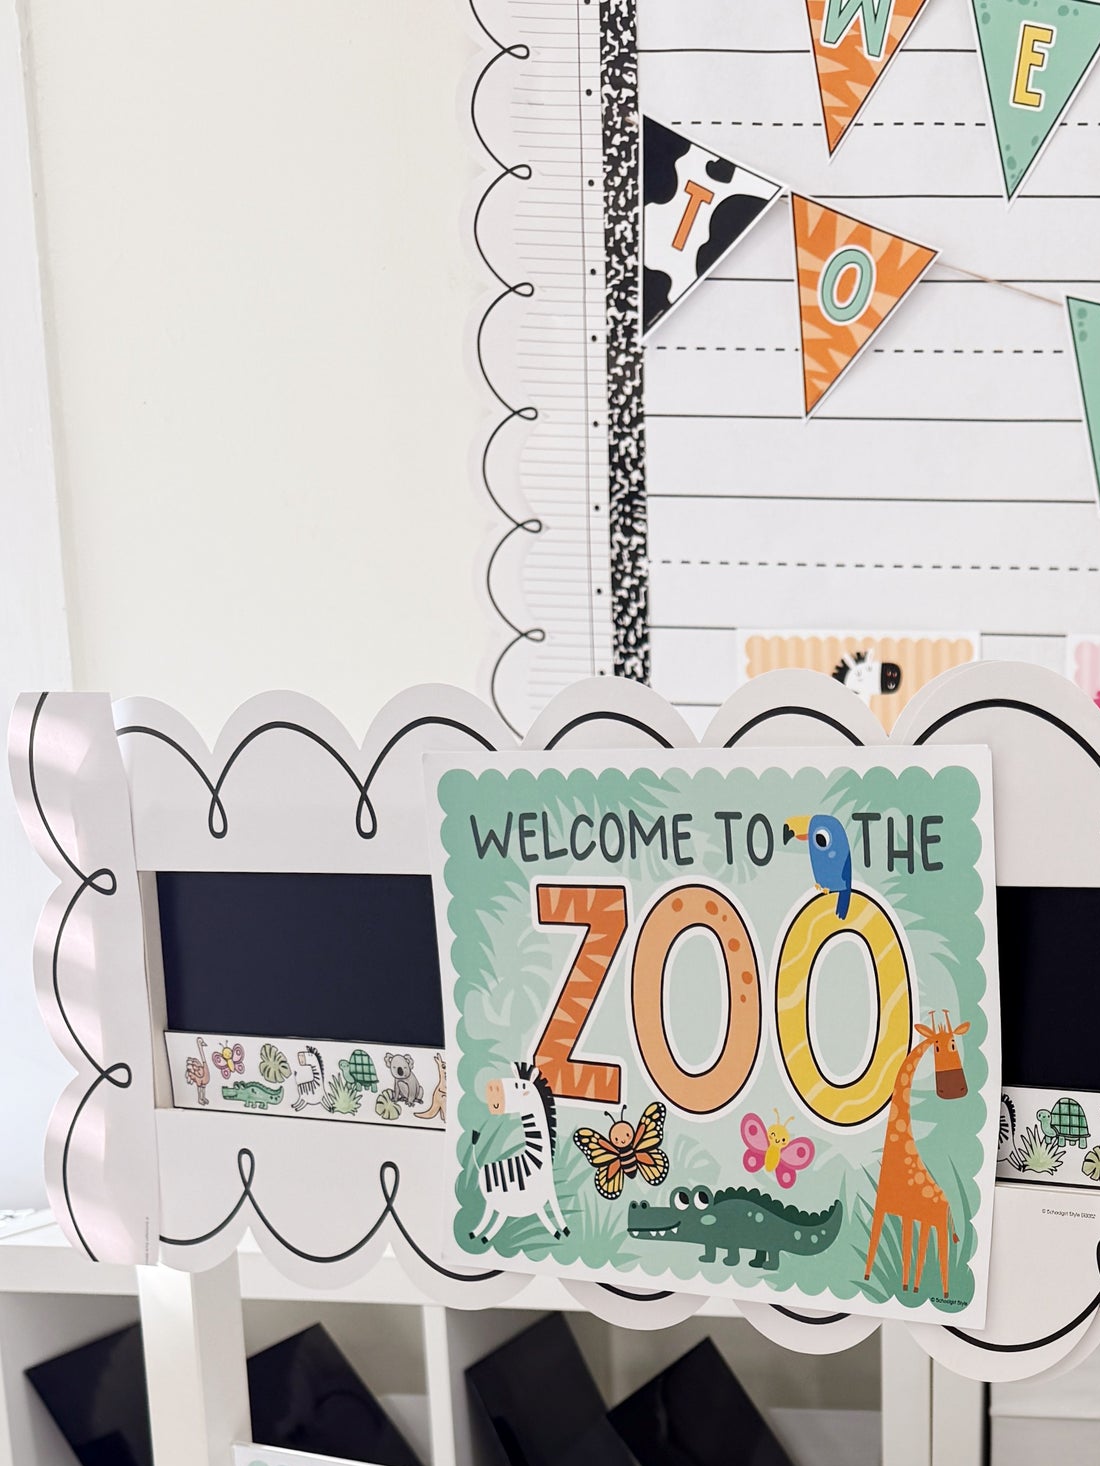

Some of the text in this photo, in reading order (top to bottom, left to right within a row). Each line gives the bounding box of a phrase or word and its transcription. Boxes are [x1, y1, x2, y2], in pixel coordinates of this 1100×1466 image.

[469, 810, 944, 874] WELCOME TO THE
[533, 883, 914, 1128] ZOO
